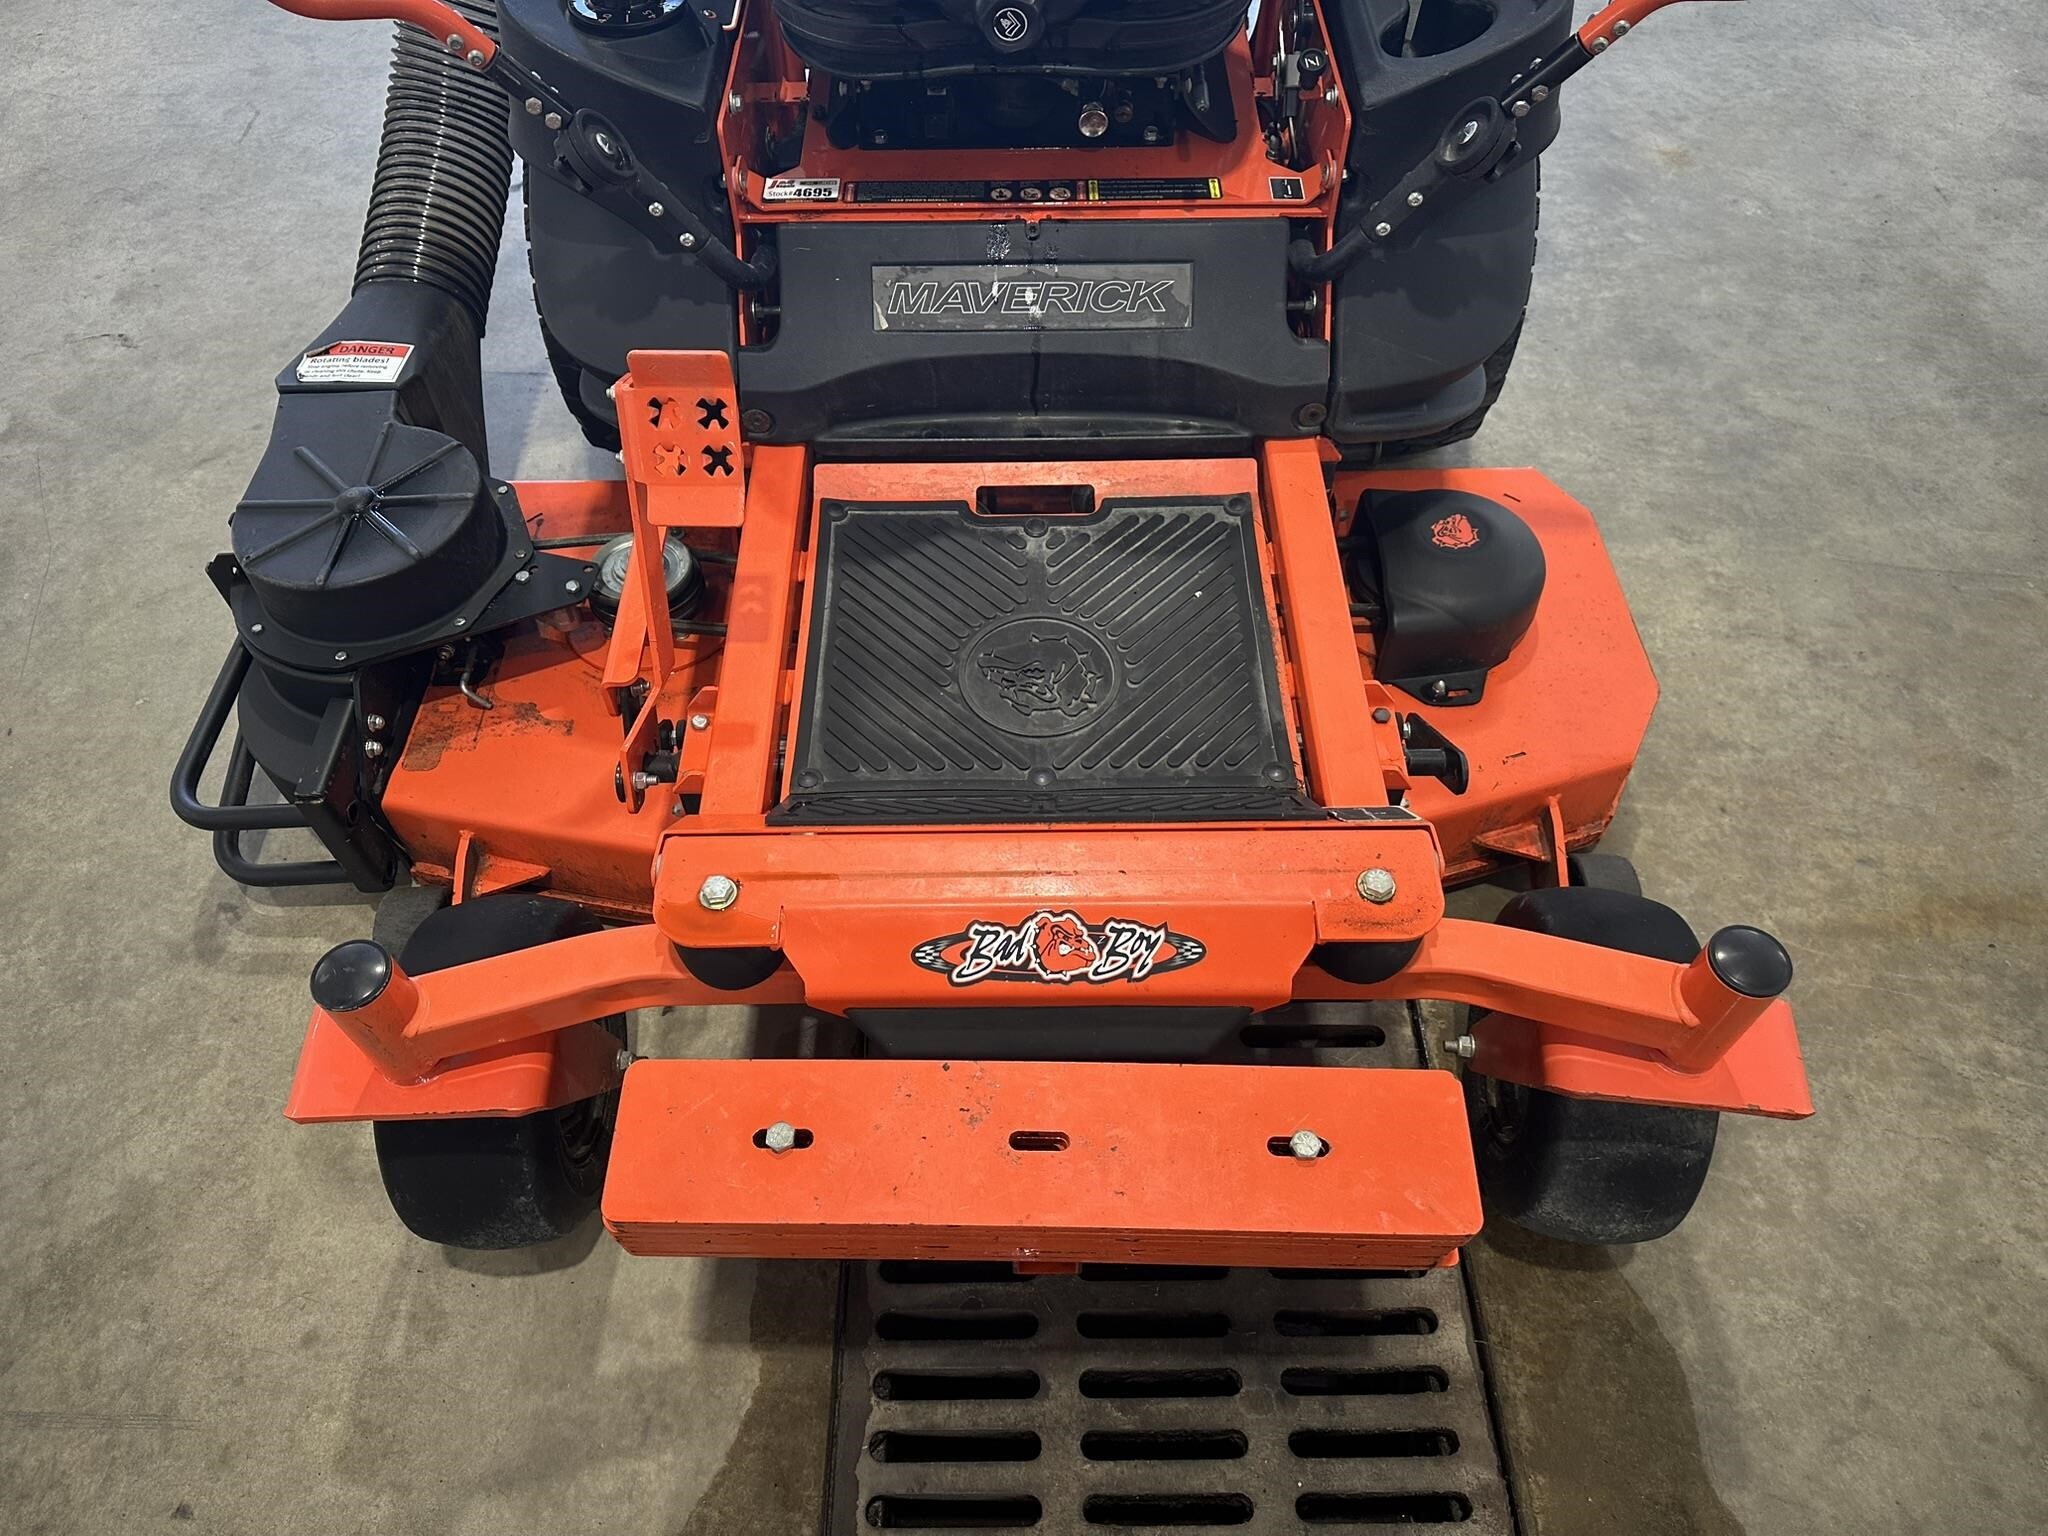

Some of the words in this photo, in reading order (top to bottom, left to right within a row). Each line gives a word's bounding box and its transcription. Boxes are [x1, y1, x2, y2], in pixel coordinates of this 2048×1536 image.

[793, 187, 833, 197] 4695
[887, 280, 1175, 314] MAVERICK
[339, 345, 395, 355] DANGER
[310, 357, 351, 365] Rotating
[352, 356, 390, 364] blades!
[955, 925, 1033, 979] Bad
[1092, 920, 1163, 977] Boy
